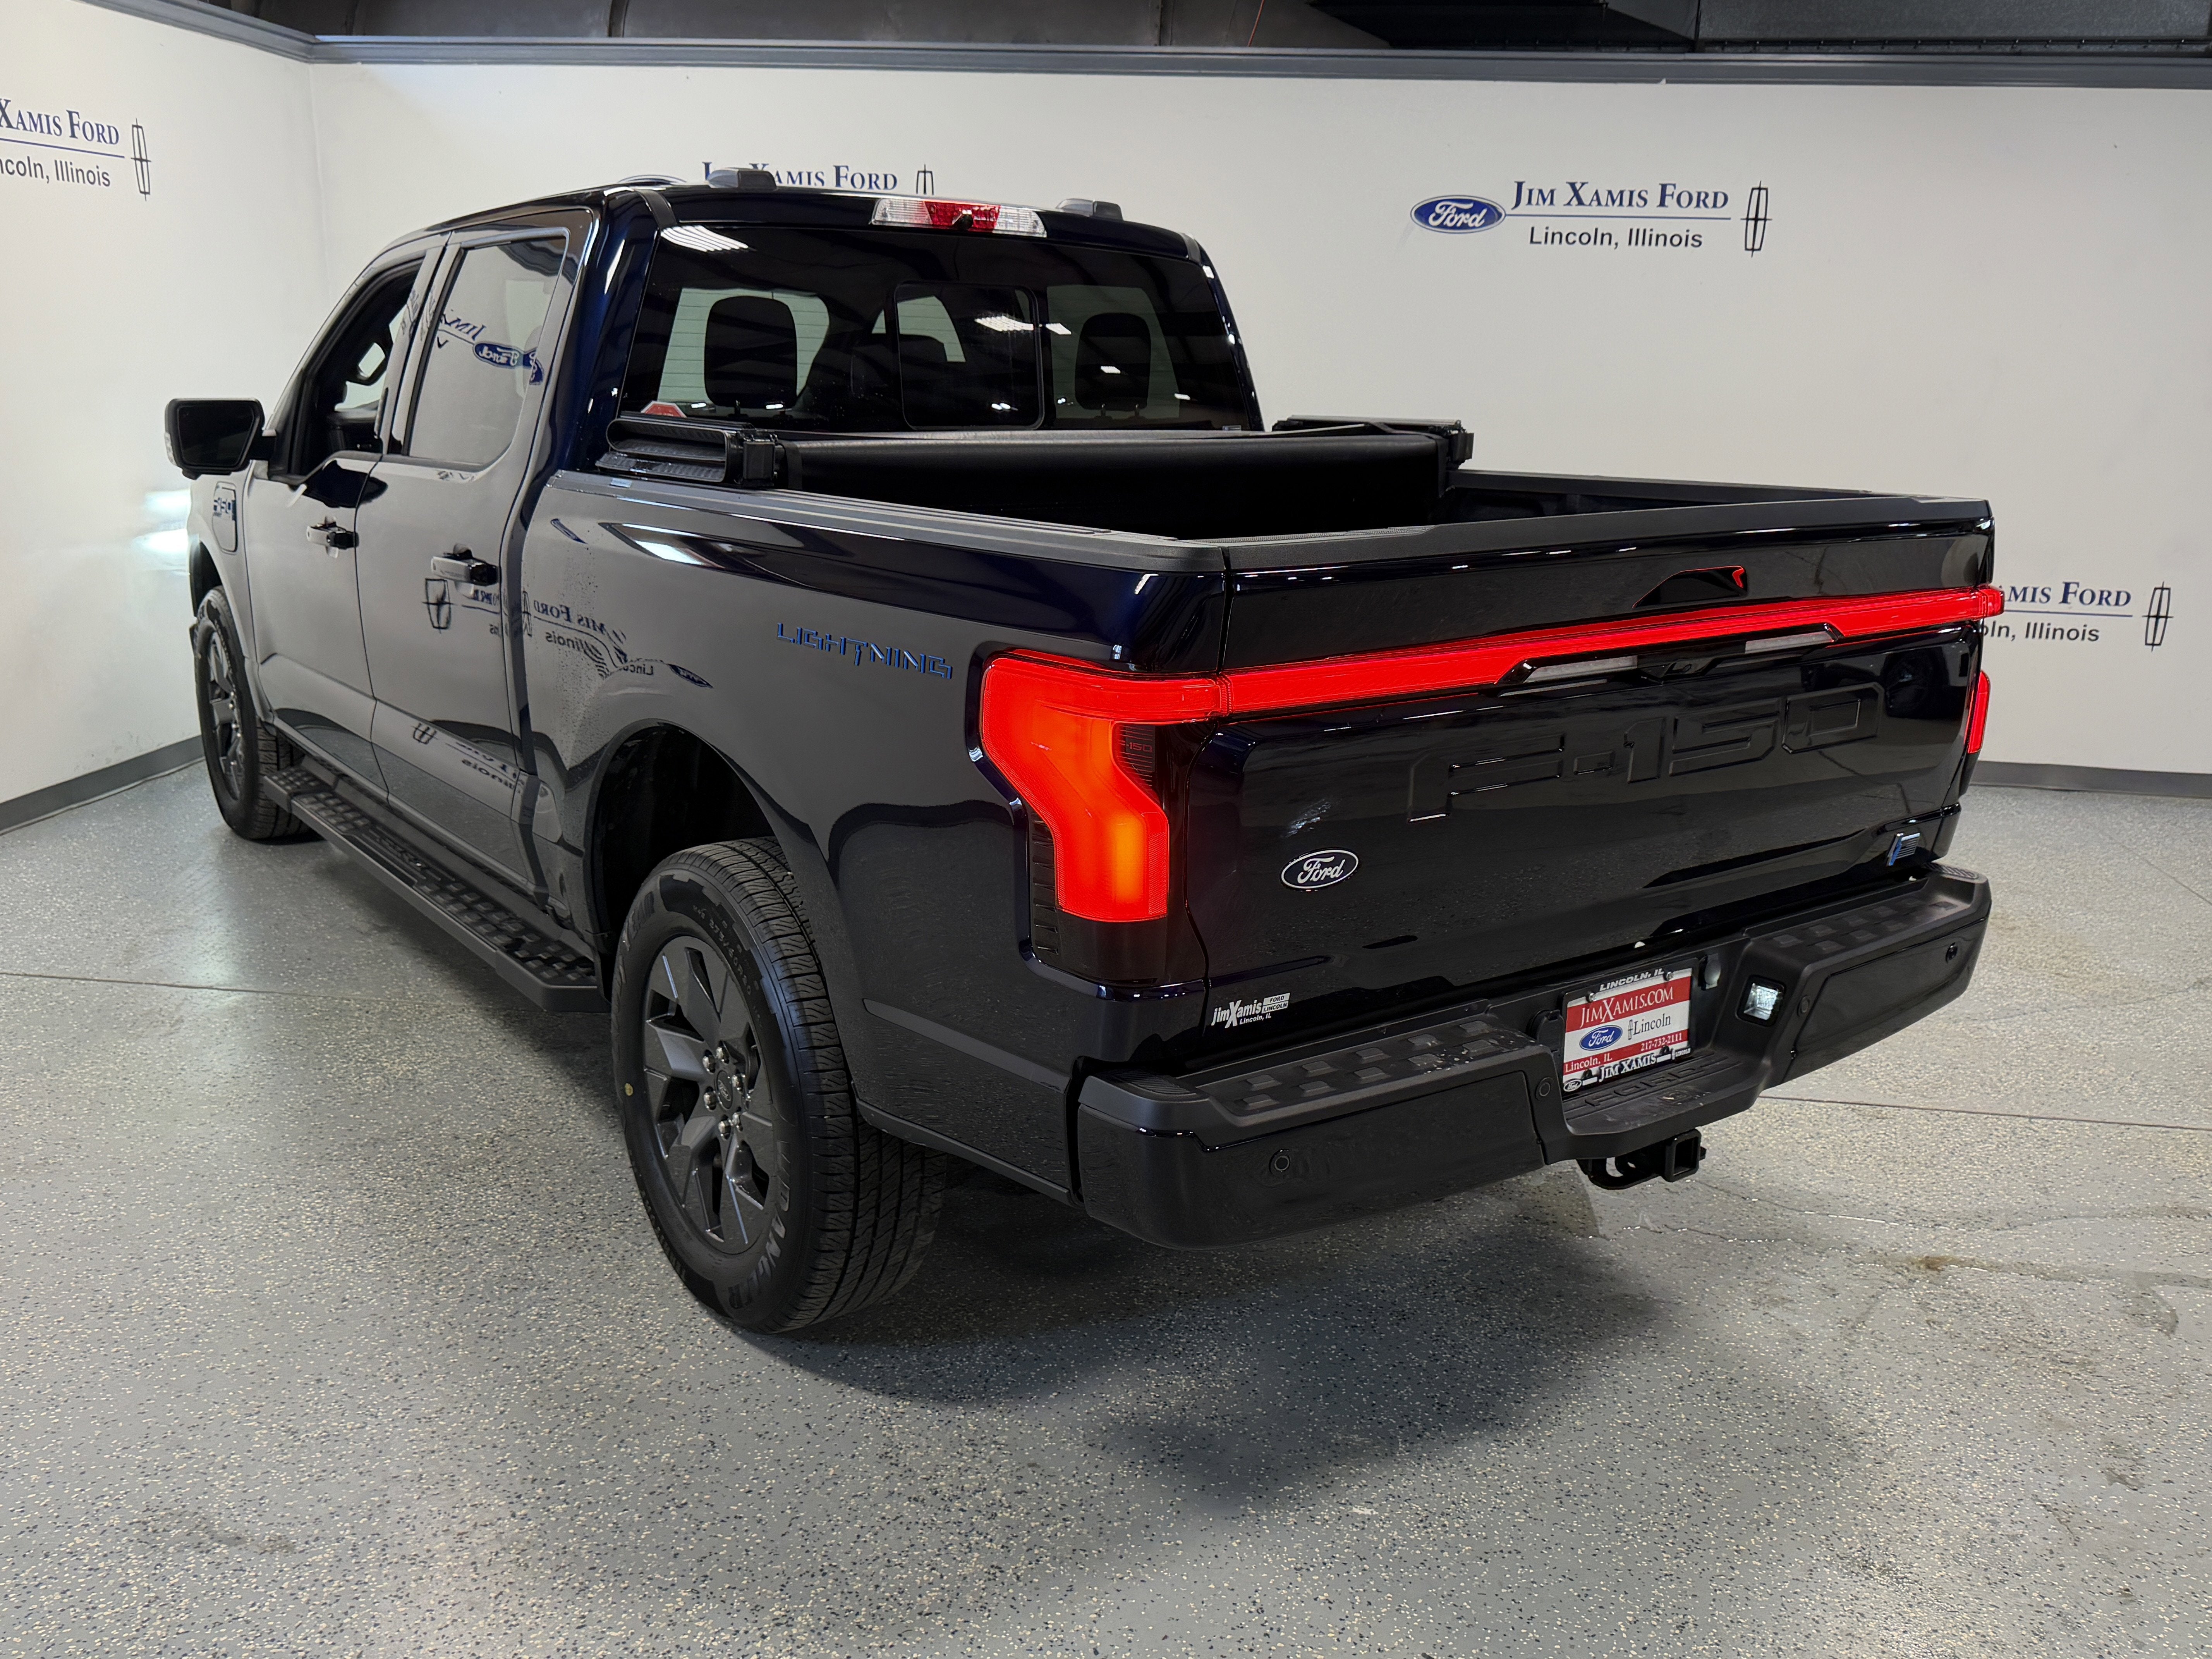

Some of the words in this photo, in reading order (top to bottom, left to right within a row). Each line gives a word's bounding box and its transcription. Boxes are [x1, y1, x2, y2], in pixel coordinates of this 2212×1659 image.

[66, 110, 119, 145] FORD
[54, 159, 111, 187] Illinois
[833, 165, 898, 190] FORD
[1511, 180, 1556, 210] JIM
[1564, 181, 1648, 210] XAMIS
[1657, 182, 1729, 210] FORD
[1428, 201, 1487, 228] Ford
[1530, 226, 1619, 249] Lincoln,
[1627, 228, 1703, 248] Illinois
[2004, 585, 2052, 604] MIS
[2058, 581, 2131, 606] FORD
[2025, 622, 2100, 642] Illinois
[777, 622, 952, 680] LIGHTNING
[1407, 682, 1886, 823] F-150
[1297, 856, 1345, 884] Ford
[1599, 971, 1652, 992] LINCOLN,
[1654, 968, 1664, 978] IL
[1239, 1014, 1264, 1025] Lincoln,
[1264, 1003, 1288, 1012] LINCOLN
[1633, 1013, 1671, 1036] Lincoln
[1588, 1029, 1614, 1047] Ford
[1640, 1032, 1682, 1051] 217-732-2111
[1599, 1065, 1620, 1083] JIM
[1621, 1054, 1657, 1074] XAMIS
[1604, 1053, 1613, 1062] IL
